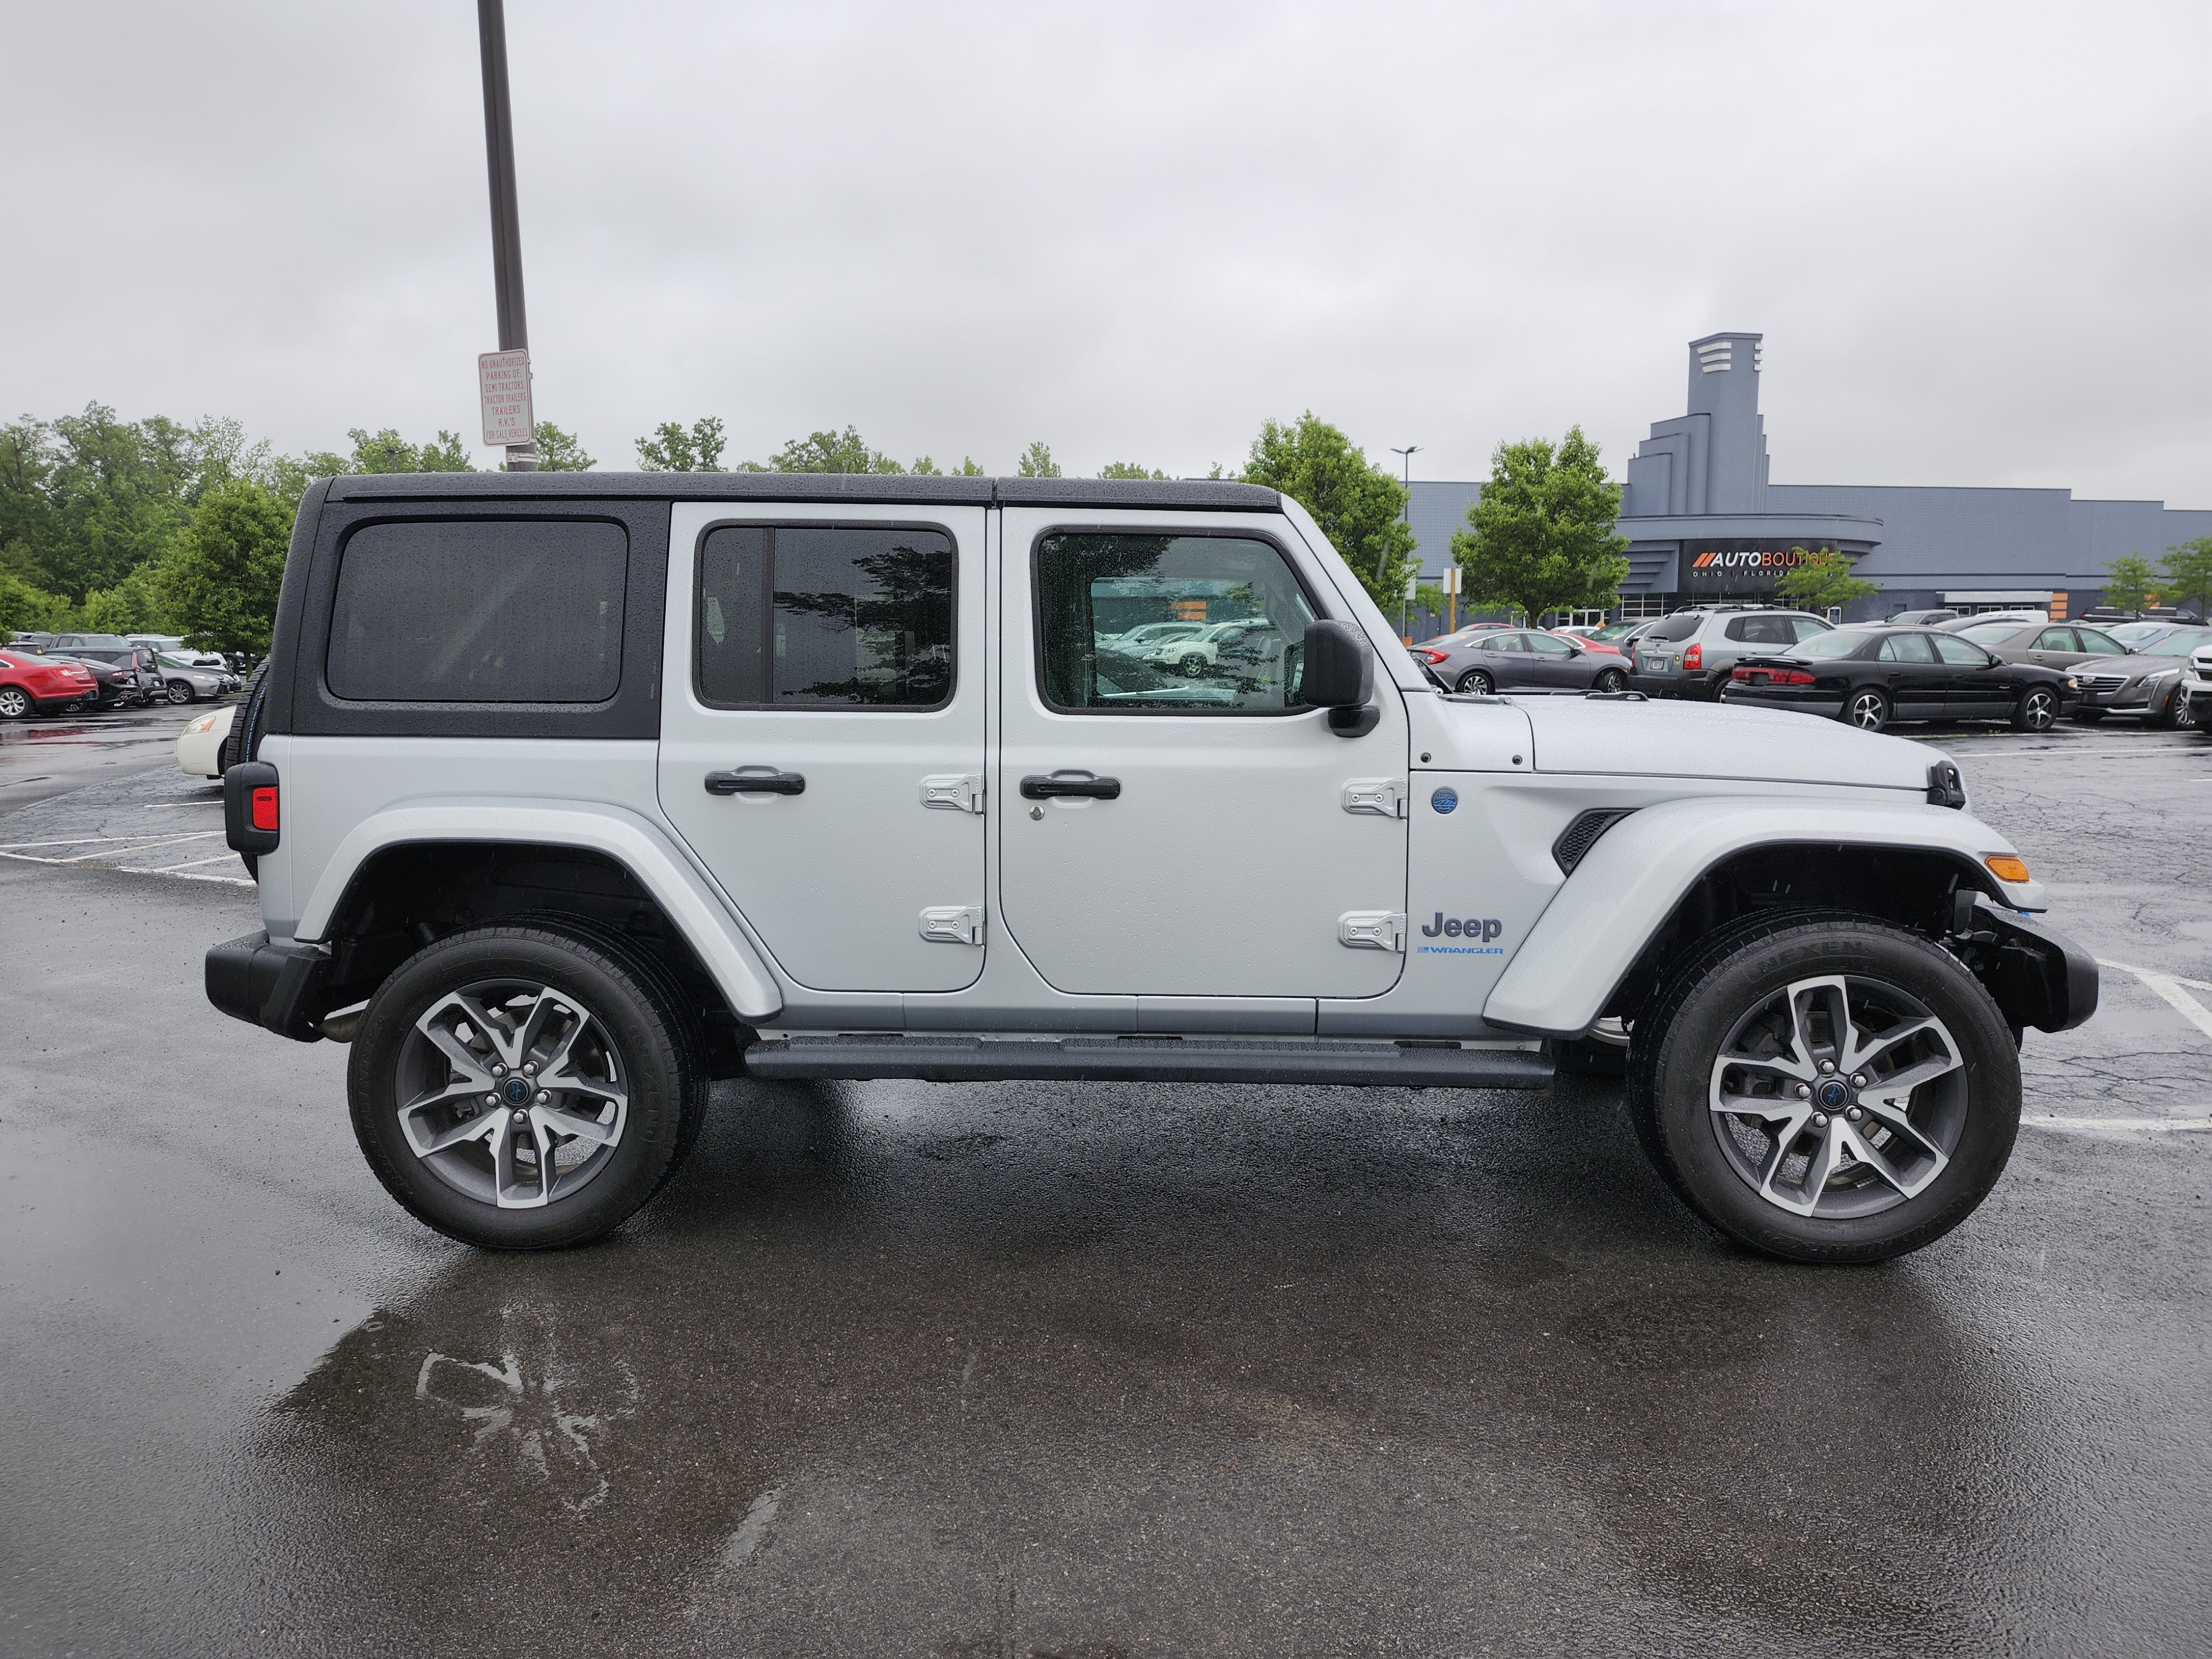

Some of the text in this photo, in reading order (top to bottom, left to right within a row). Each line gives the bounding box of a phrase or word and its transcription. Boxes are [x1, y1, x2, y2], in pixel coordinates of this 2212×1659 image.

[481, 357, 524, 369] NO UNAUTHORIZED
[486, 369, 521, 380] PARKING OF:
[485, 380, 524, 393] SEMI TRACTORS
[484, 392, 526, 404] TRACTOR TRAILERS
[492, 405, 520, 415] TRAILERS
[498, 418, 515, 427] R.V.'S
[497, 430, 507, 439] SALE
[509, 427, 528, 437] VEHICLES
[1422, 911, 1502, 942] Jeep
